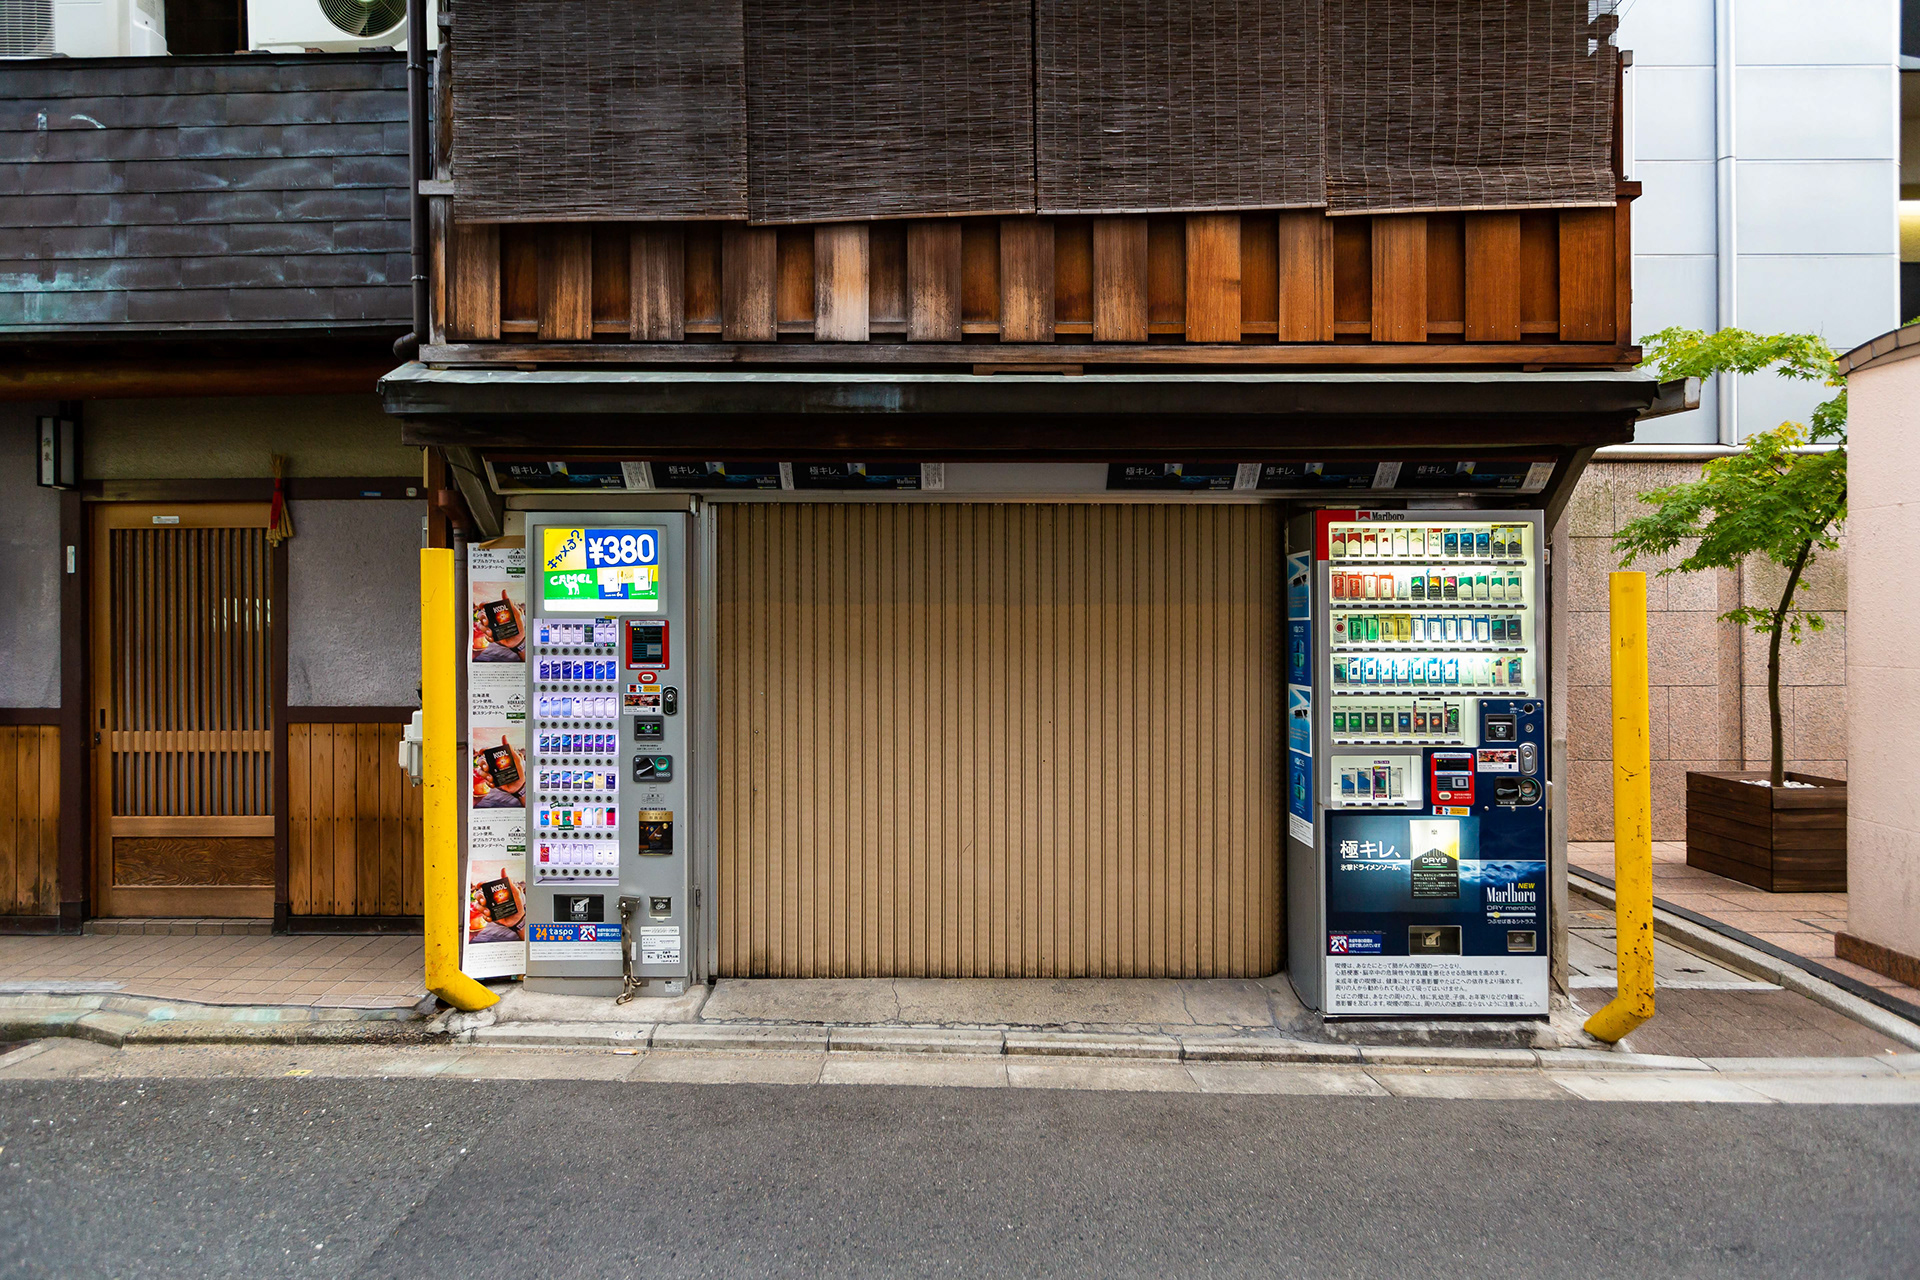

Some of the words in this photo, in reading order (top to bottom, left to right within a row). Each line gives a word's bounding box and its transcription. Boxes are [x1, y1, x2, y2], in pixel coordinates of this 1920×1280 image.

[1372, 511, 1404, 521] Marlboro
[588, 533, 655, 565] ¥380
[550, 573, 593, 585] CAMEL
[1340, 840, 1401, 859] 極キレ、
[1486, 883, 1536, 903] Marlboro
[535, 928, 548, 938] 24
[549, 928, 574, 936] taspo
[580, 929, 596, 941] 20
[1331, 940, 1347, 952] 20
